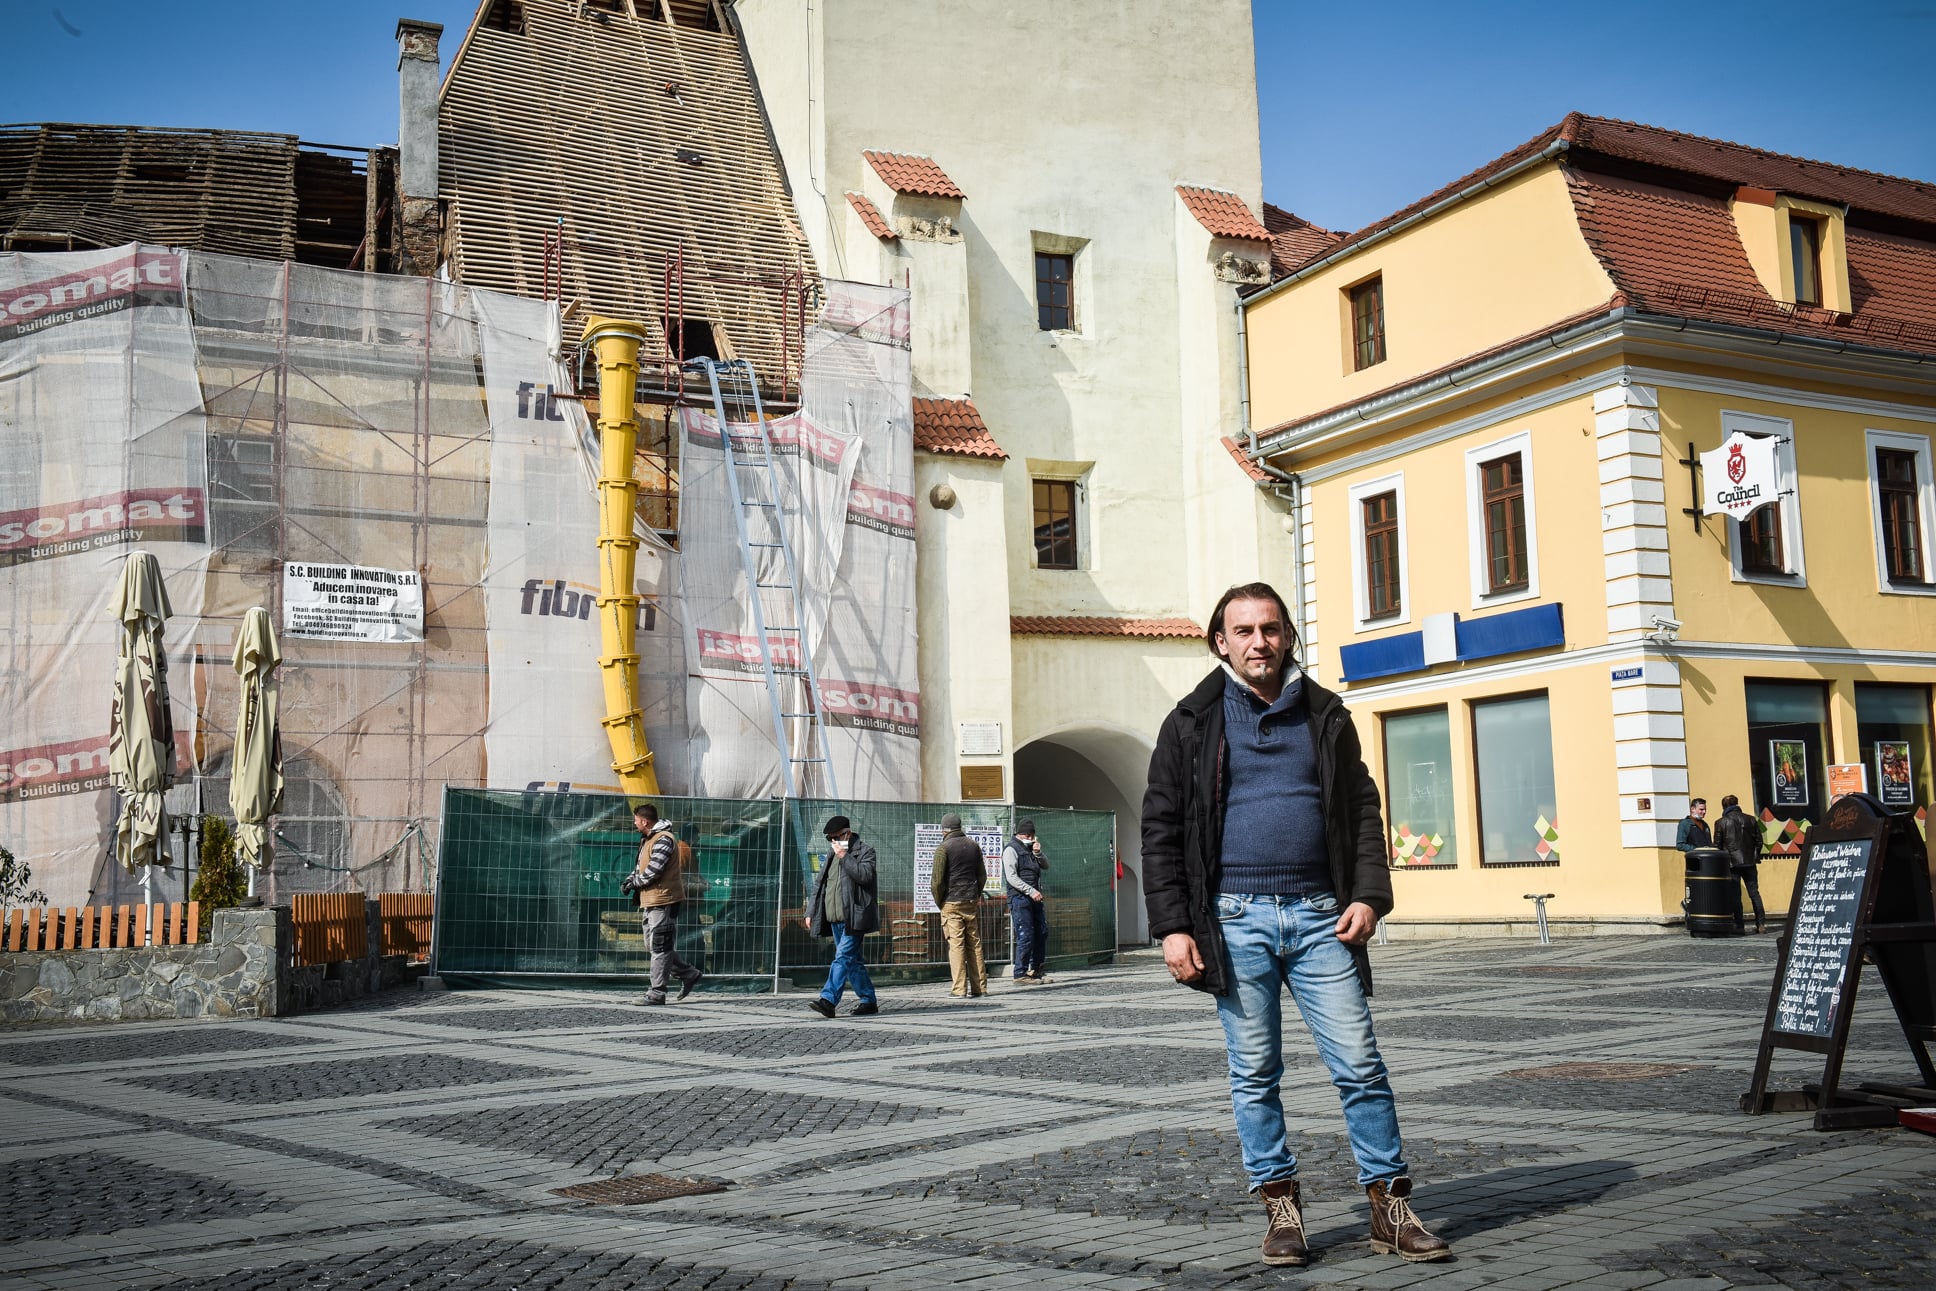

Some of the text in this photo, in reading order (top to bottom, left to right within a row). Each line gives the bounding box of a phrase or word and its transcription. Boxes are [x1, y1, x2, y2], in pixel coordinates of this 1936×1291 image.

[0, 259, 172, 321] omat
[16, 298, 125, 334] building quality
[861, 329, 902, 346] building
[1717, 484, 1761, 504] Council
[848, 512, 889, 533] building
[31, 529, 144, 558] building quality
[289, 566, 305, 578] S.C.
[307, 566, 347, 580] BUILDING
[350, 568, 397, 584] INNOVATION
[328, 594, 338, 604] in
[340, 595, 364, 605] casa
[356, 584, 398, 597] inovarea
[520, 578, 658, 632] fibrn
[853, 716, 895, 733] building
[19, 778, 80, 798] building
[1812, 845, 1840, 860] Restaurant
